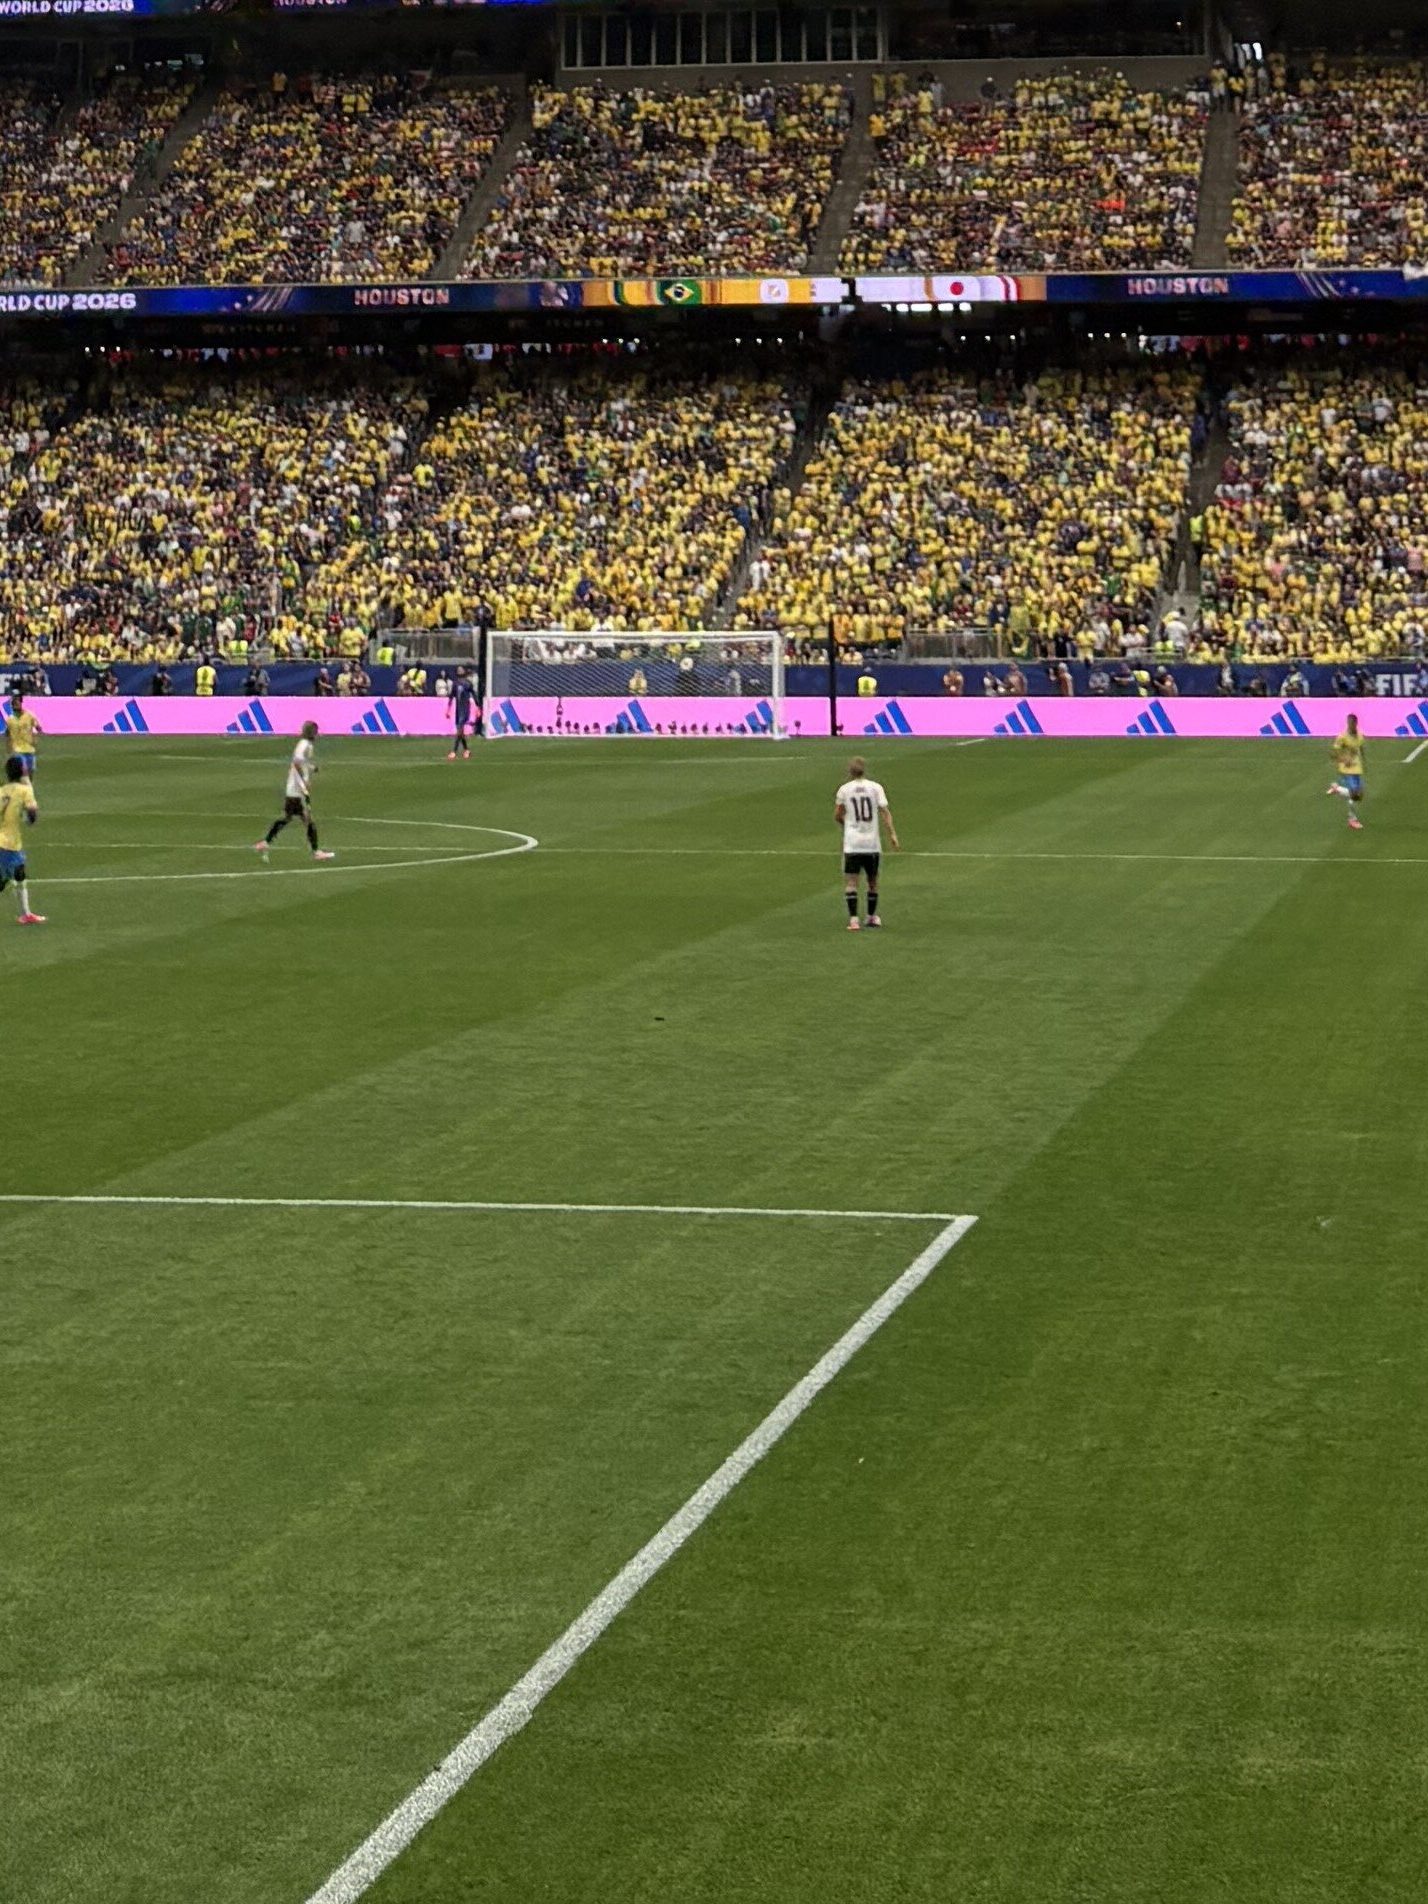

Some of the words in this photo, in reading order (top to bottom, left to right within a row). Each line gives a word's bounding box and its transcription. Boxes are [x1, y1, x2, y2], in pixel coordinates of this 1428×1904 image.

[1128, 278, 1230, 295] HOUSTON
[33, 293, 70, 311] CUP
[72, 292, 137, 310] 2026
[355, 287, 450, 306] HOUSTON
[850, 796, 873, 822] 10
